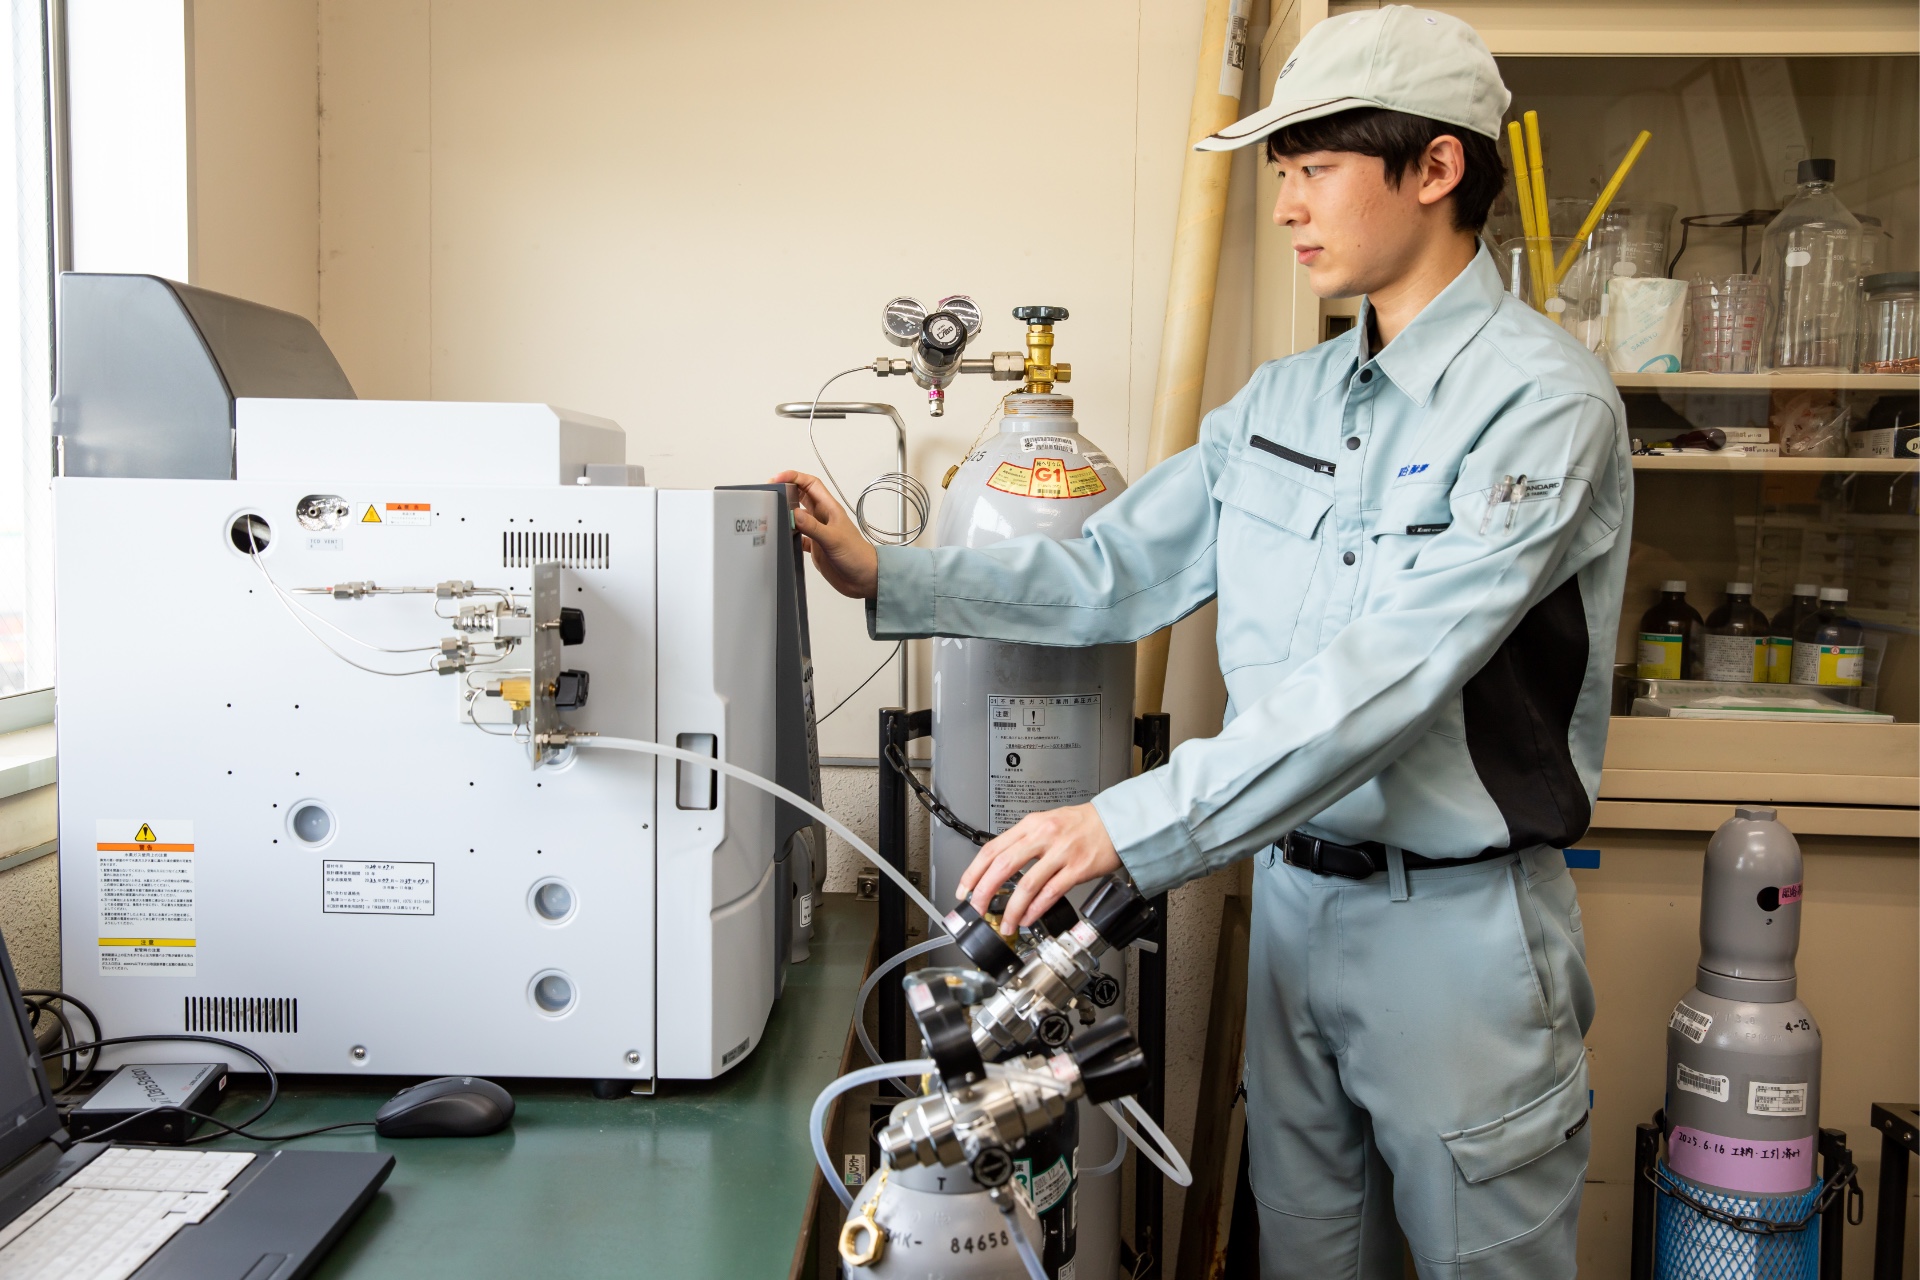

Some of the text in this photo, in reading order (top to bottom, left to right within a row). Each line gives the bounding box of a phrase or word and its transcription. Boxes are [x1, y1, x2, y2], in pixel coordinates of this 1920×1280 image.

[1034, 467, 1061, 483] G1
[995, 710, 1009, 718] 注意
[1678, 1131, 1725, 1154] 2025.6.16
[937, 1177, 947, 1191] T
[950, 1230, 1009, 1254] 84658
